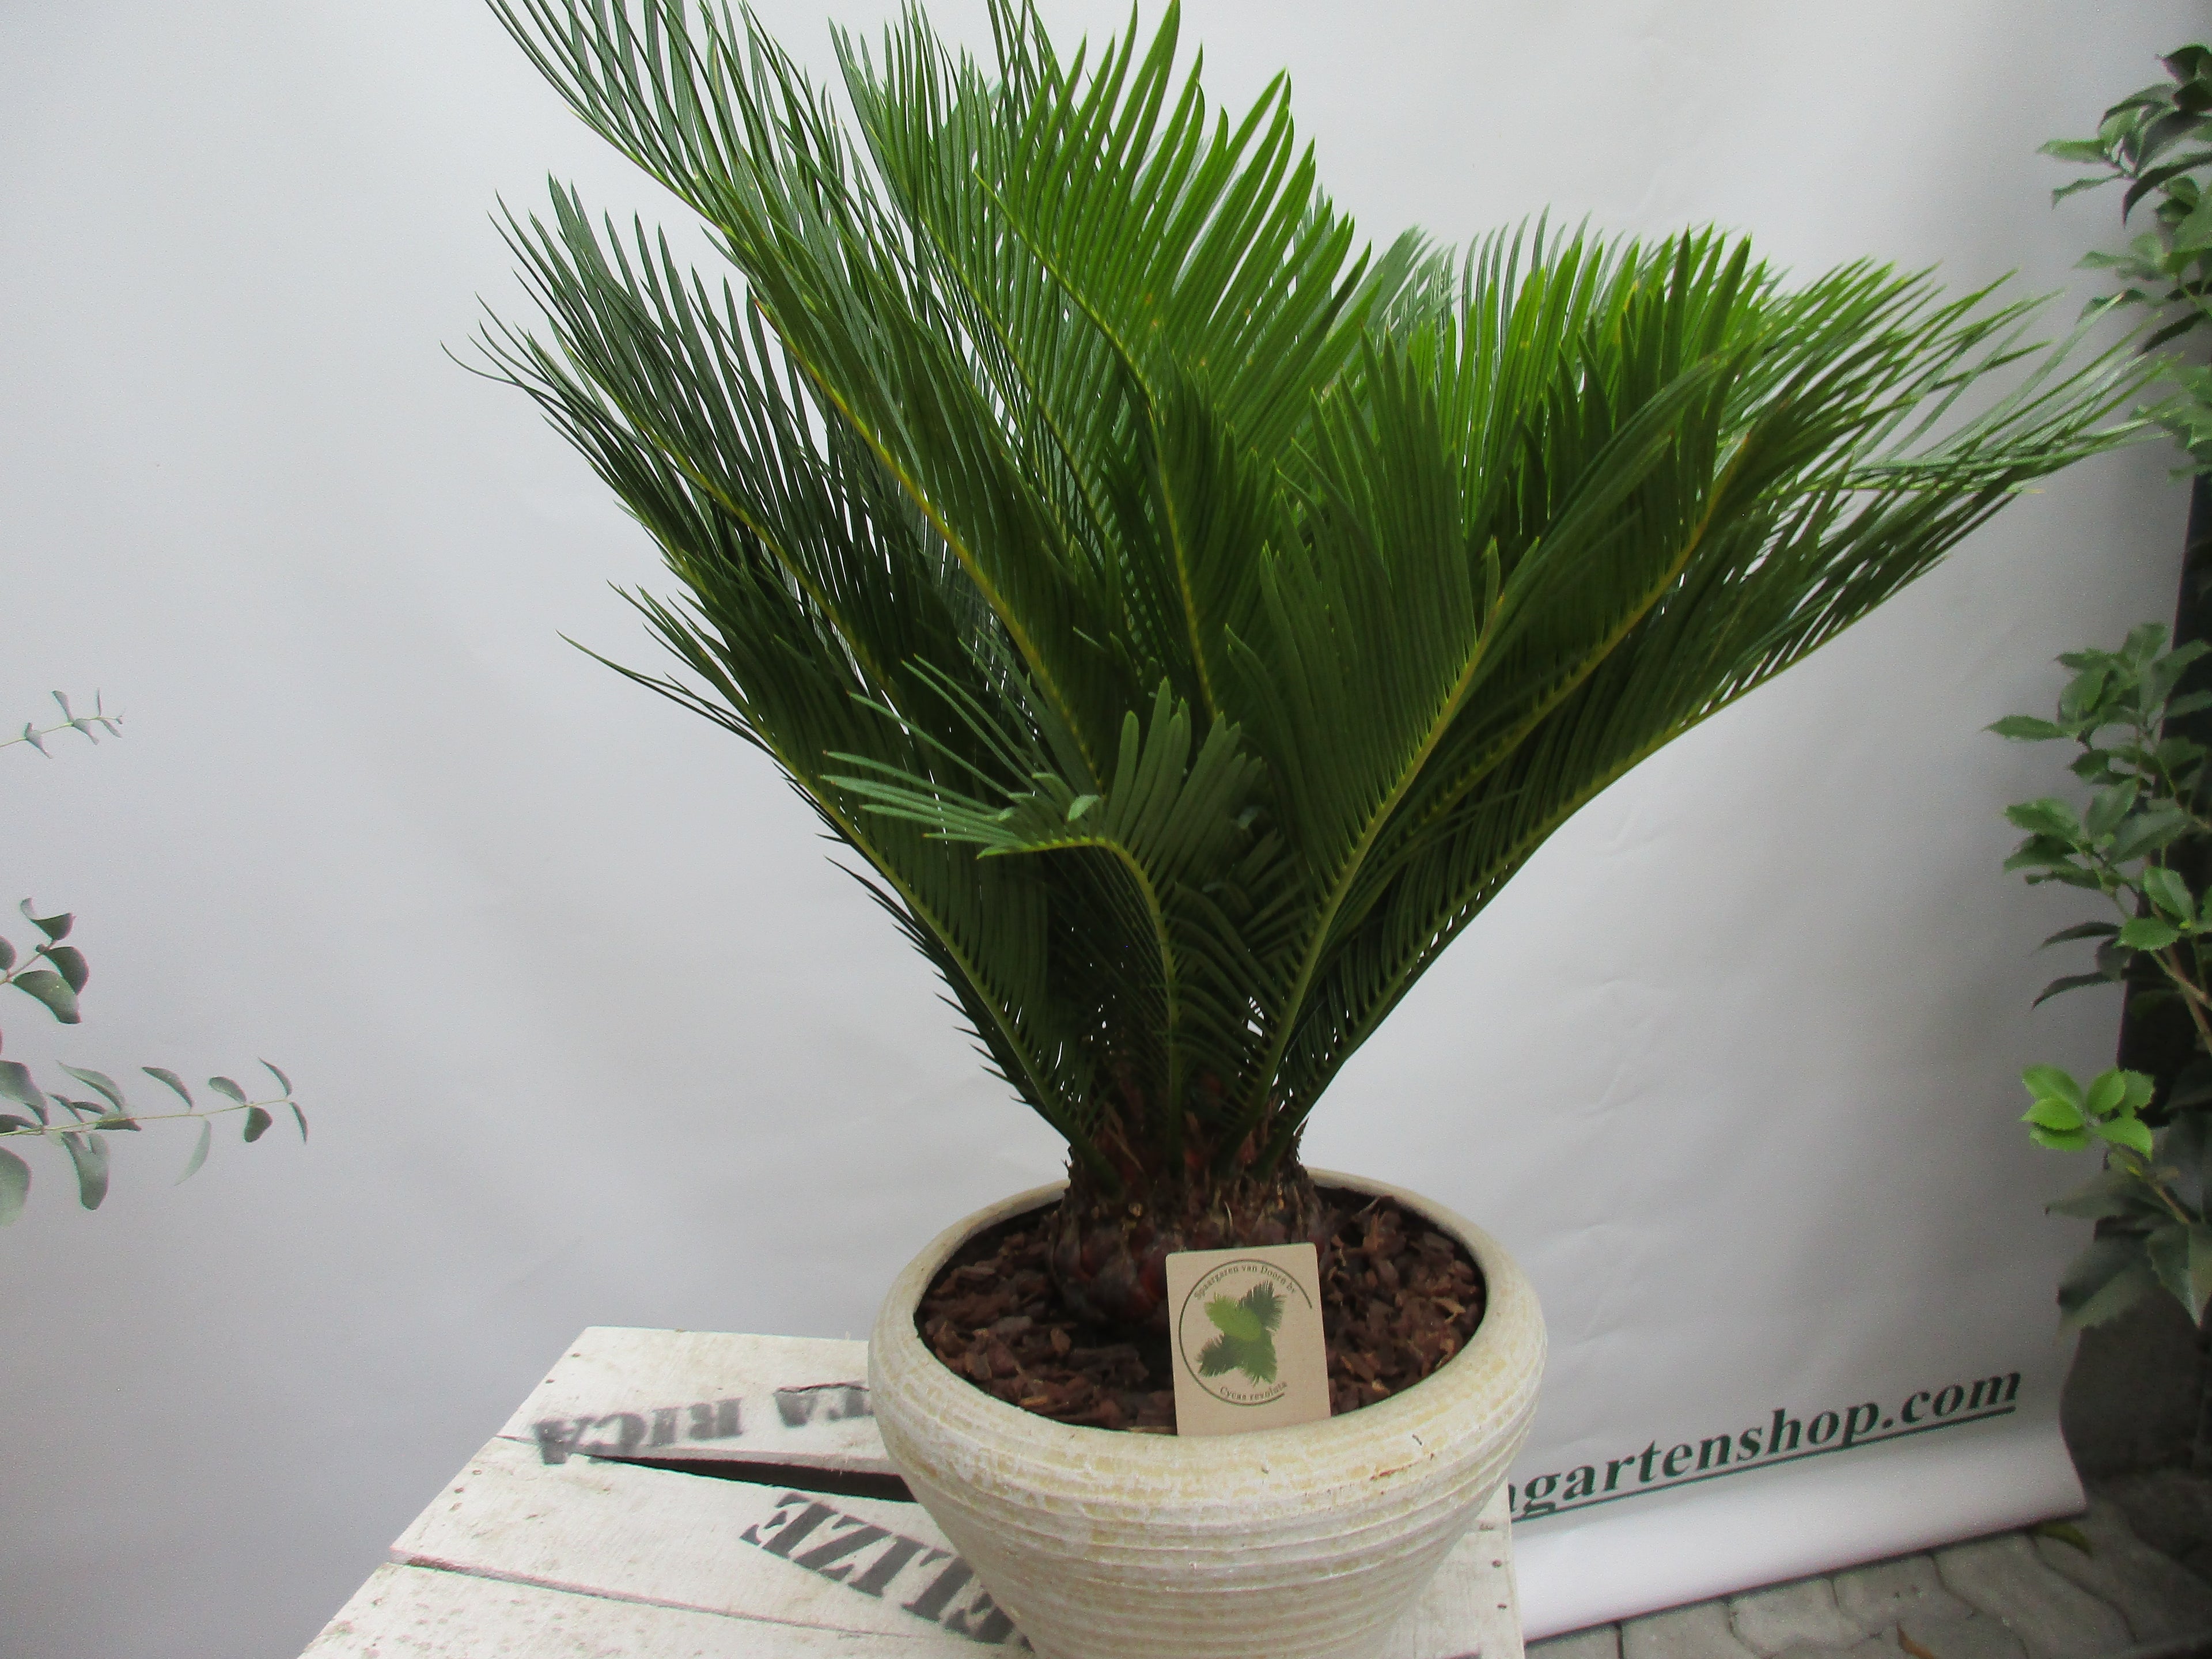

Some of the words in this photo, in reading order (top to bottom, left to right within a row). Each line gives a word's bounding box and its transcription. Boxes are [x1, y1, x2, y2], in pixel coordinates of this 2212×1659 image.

[1261, 1266, 1286, 1285] Doorn
[1220, 1386, 1246, 1401] Cycas
[1250, 1381, 1287, 1401] revoluta
[531, 1397, 743, 1465] RICA
[740, 1491, 1036, 1653] ELIZE
